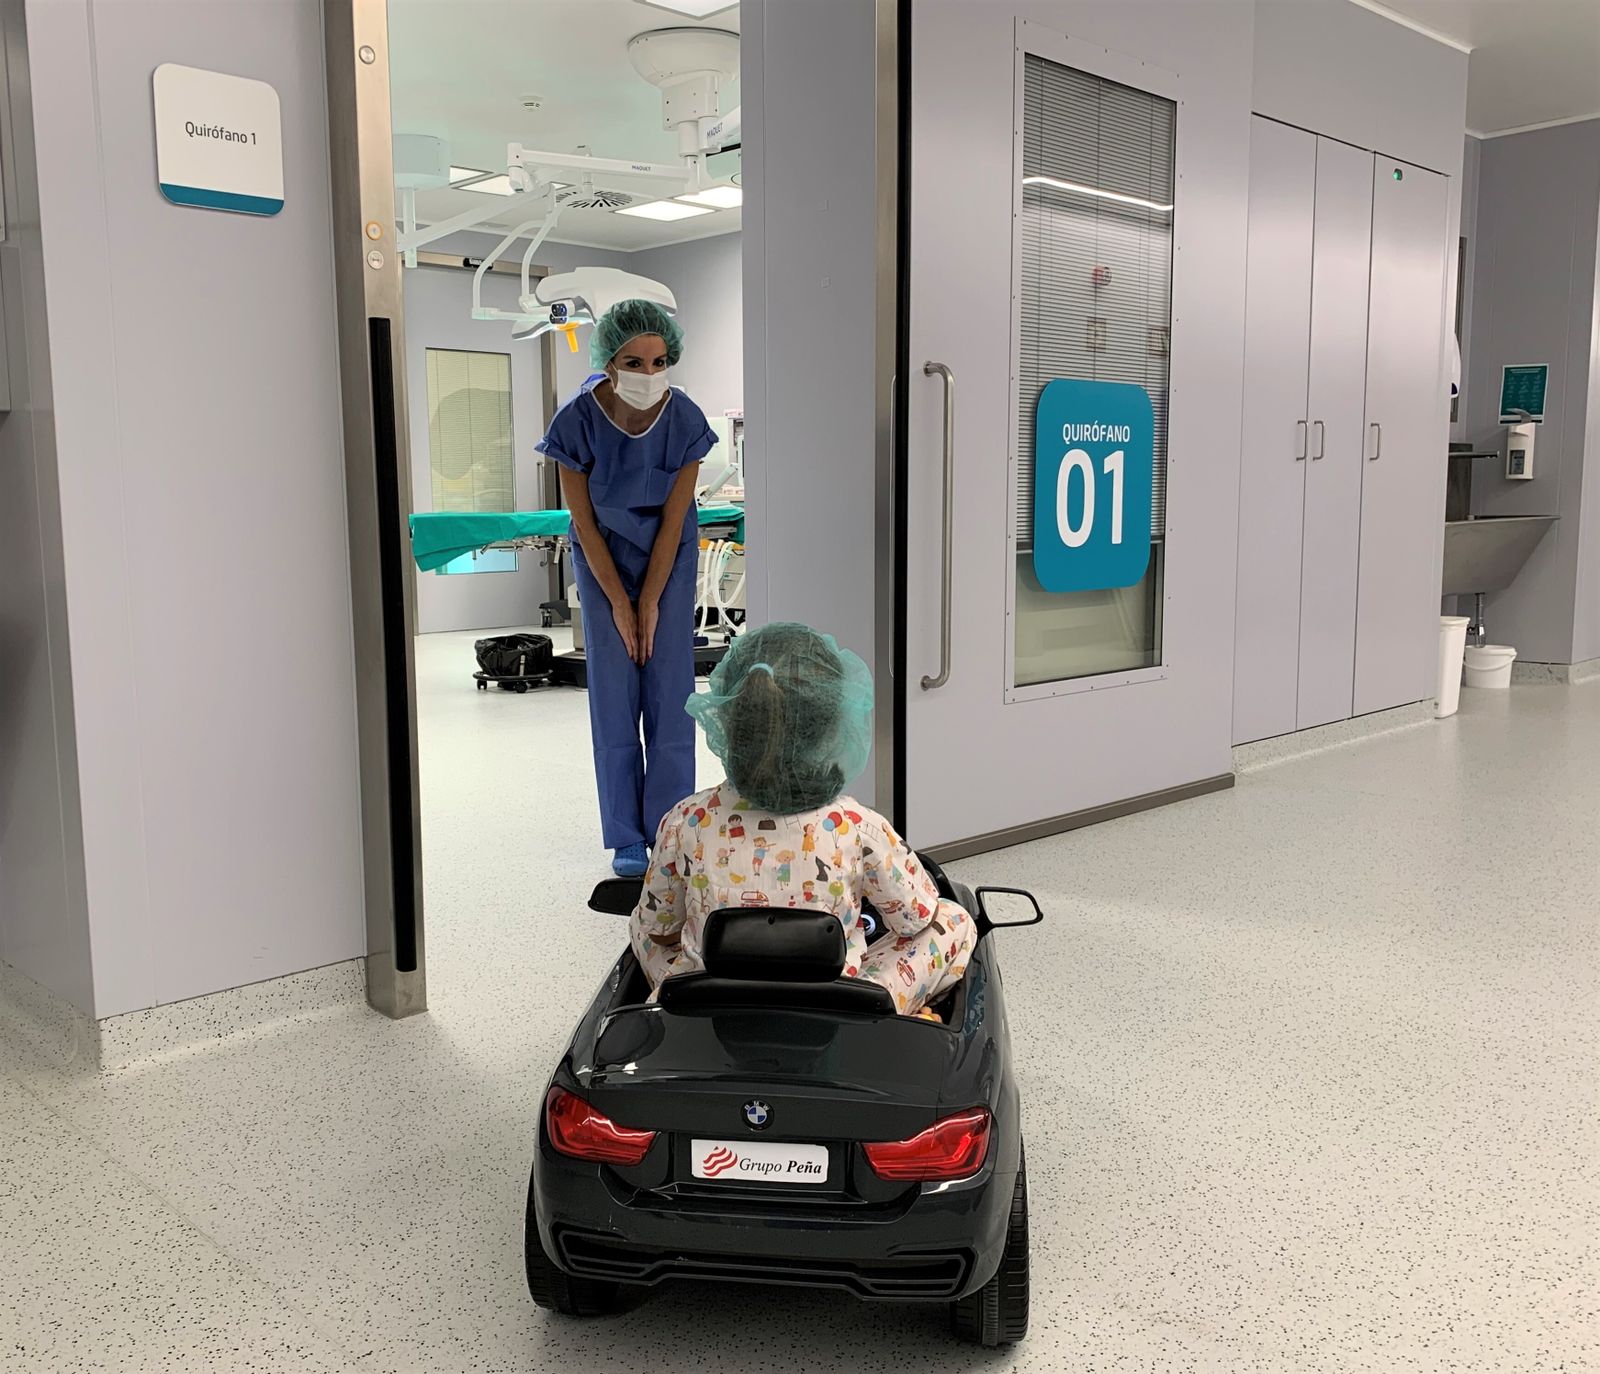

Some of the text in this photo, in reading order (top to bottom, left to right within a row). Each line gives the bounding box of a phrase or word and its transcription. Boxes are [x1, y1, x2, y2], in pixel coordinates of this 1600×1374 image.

[185, 121, 257, 145] Quirófano 1
[1063, 420, 1130, 444] QUIRÓFANO
[1056, 448, 1124, 548] 01
[744, 1101, 770, 1111] BMW
[739, 1158, 822, 1175] Grupo Peña
